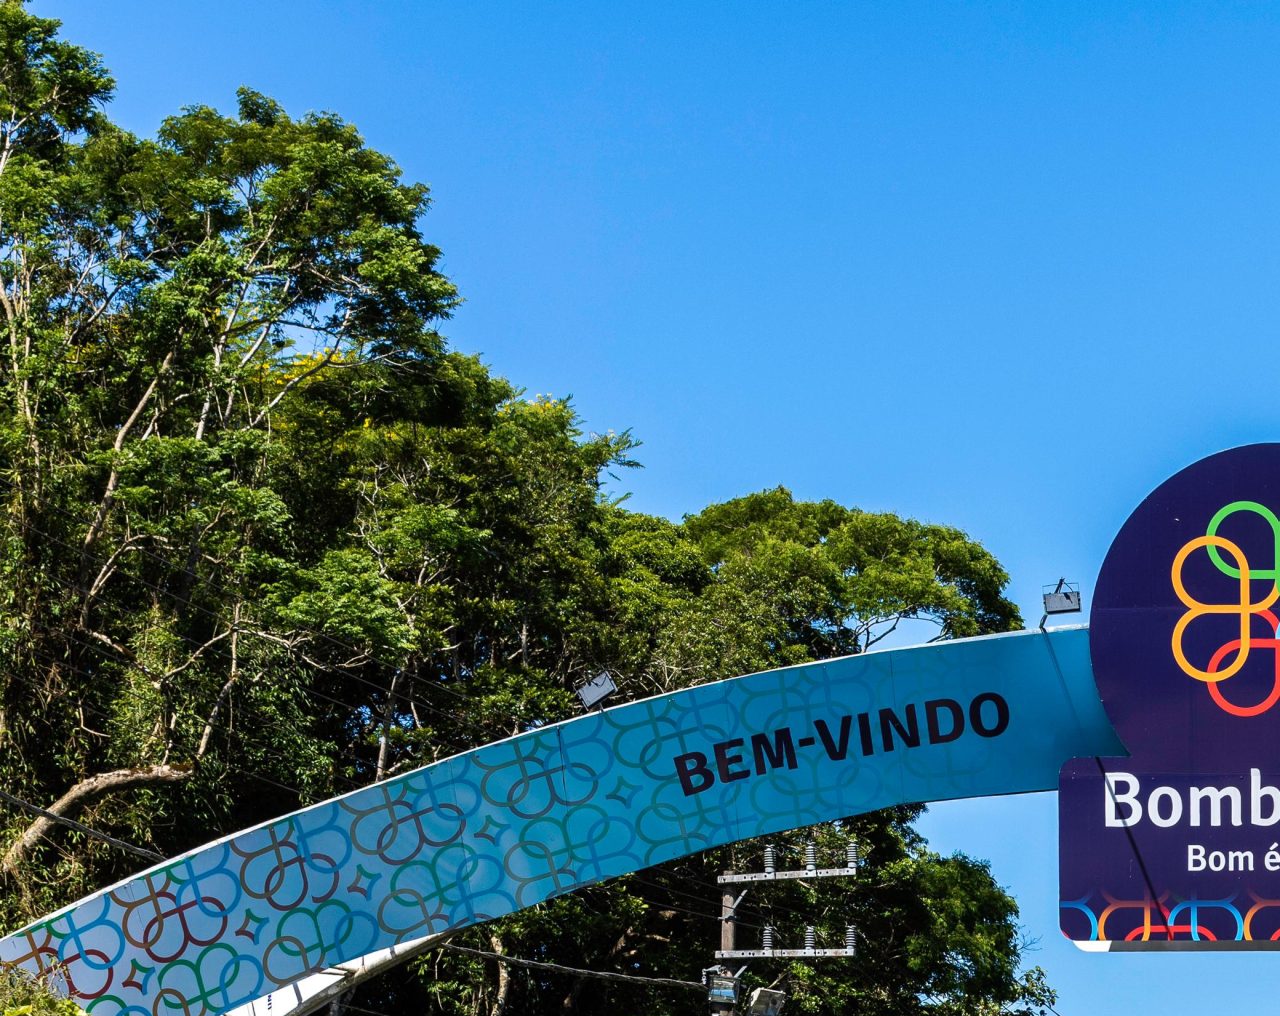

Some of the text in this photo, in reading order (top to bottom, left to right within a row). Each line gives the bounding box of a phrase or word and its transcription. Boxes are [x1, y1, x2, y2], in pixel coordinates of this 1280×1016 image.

[674, 692, 1010, 797] BEM-VINDO
[1187, 844, 1254, 872] Bom
[1264, 842, 1280, 872] é
